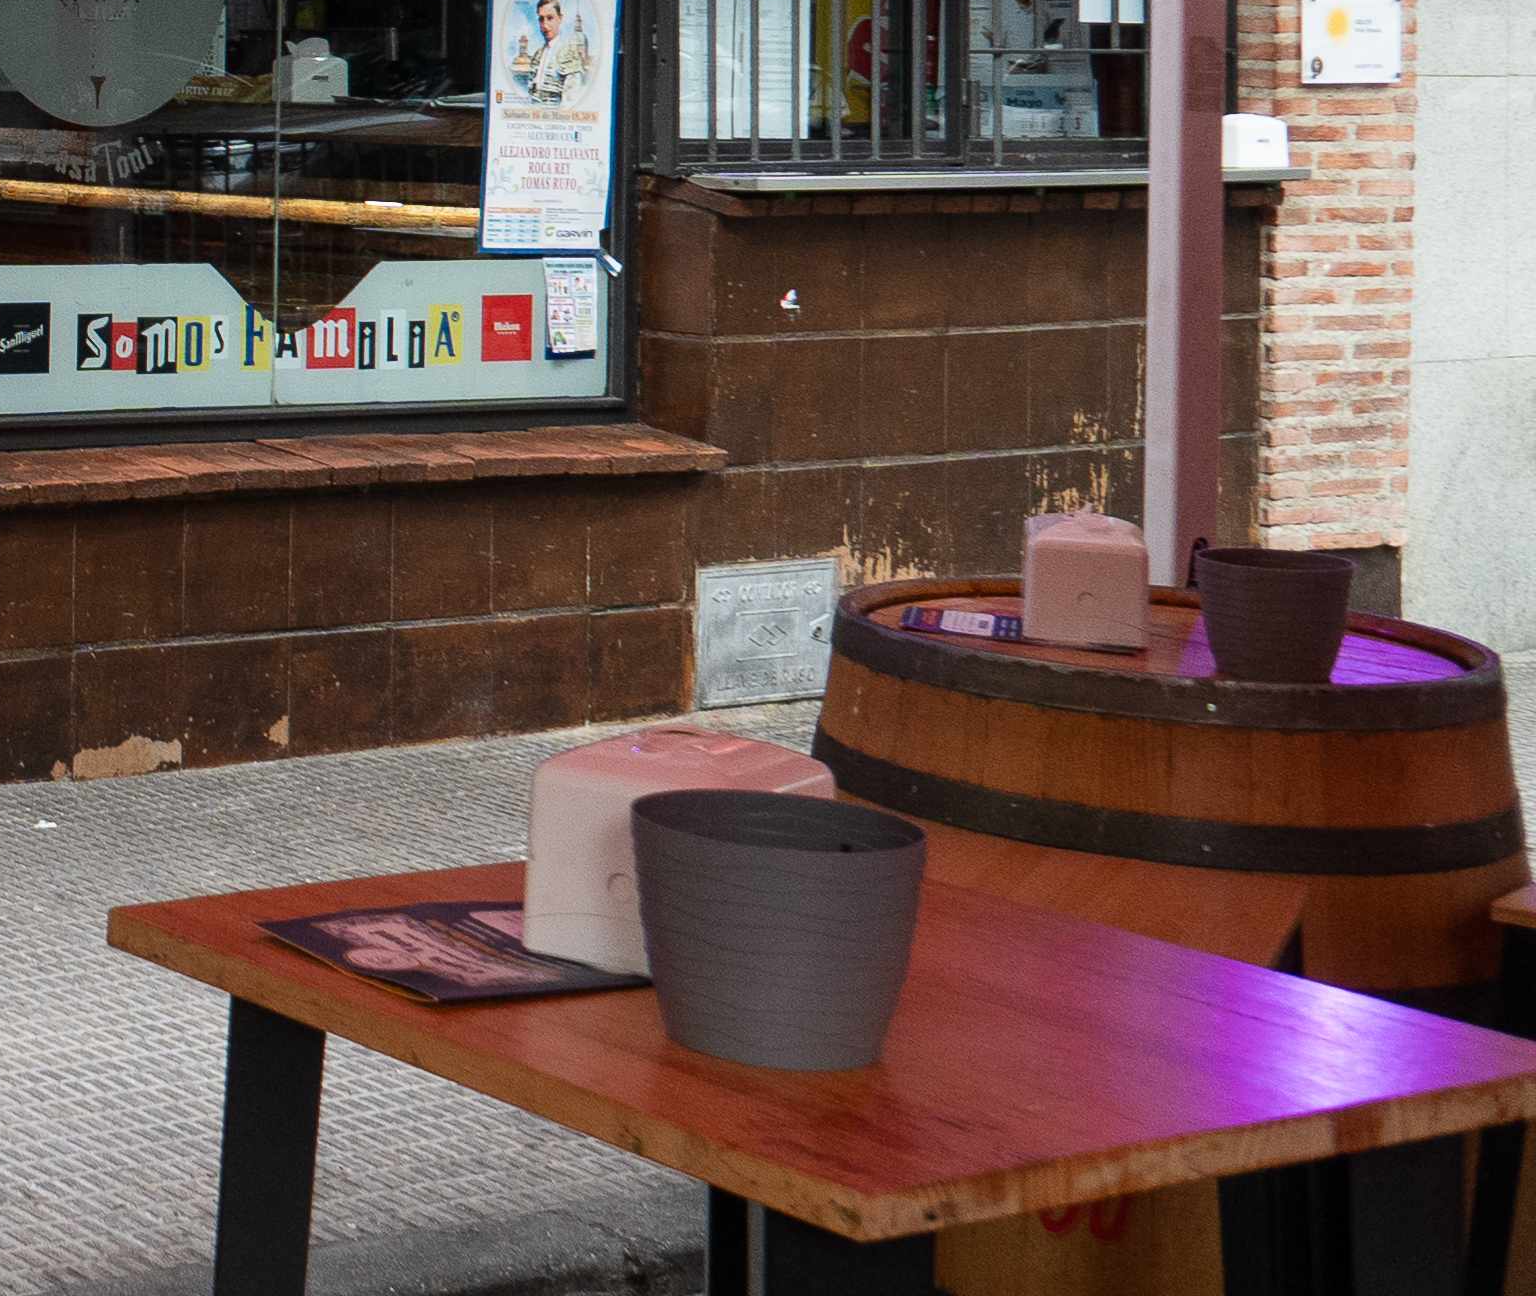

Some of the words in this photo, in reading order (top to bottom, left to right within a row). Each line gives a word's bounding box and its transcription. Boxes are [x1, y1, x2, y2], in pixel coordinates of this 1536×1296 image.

[499, 145, 552, 160] ALEJANDRO
[527, 161, 552, 174] ROCA
[554, 162, 571, 175] REY
